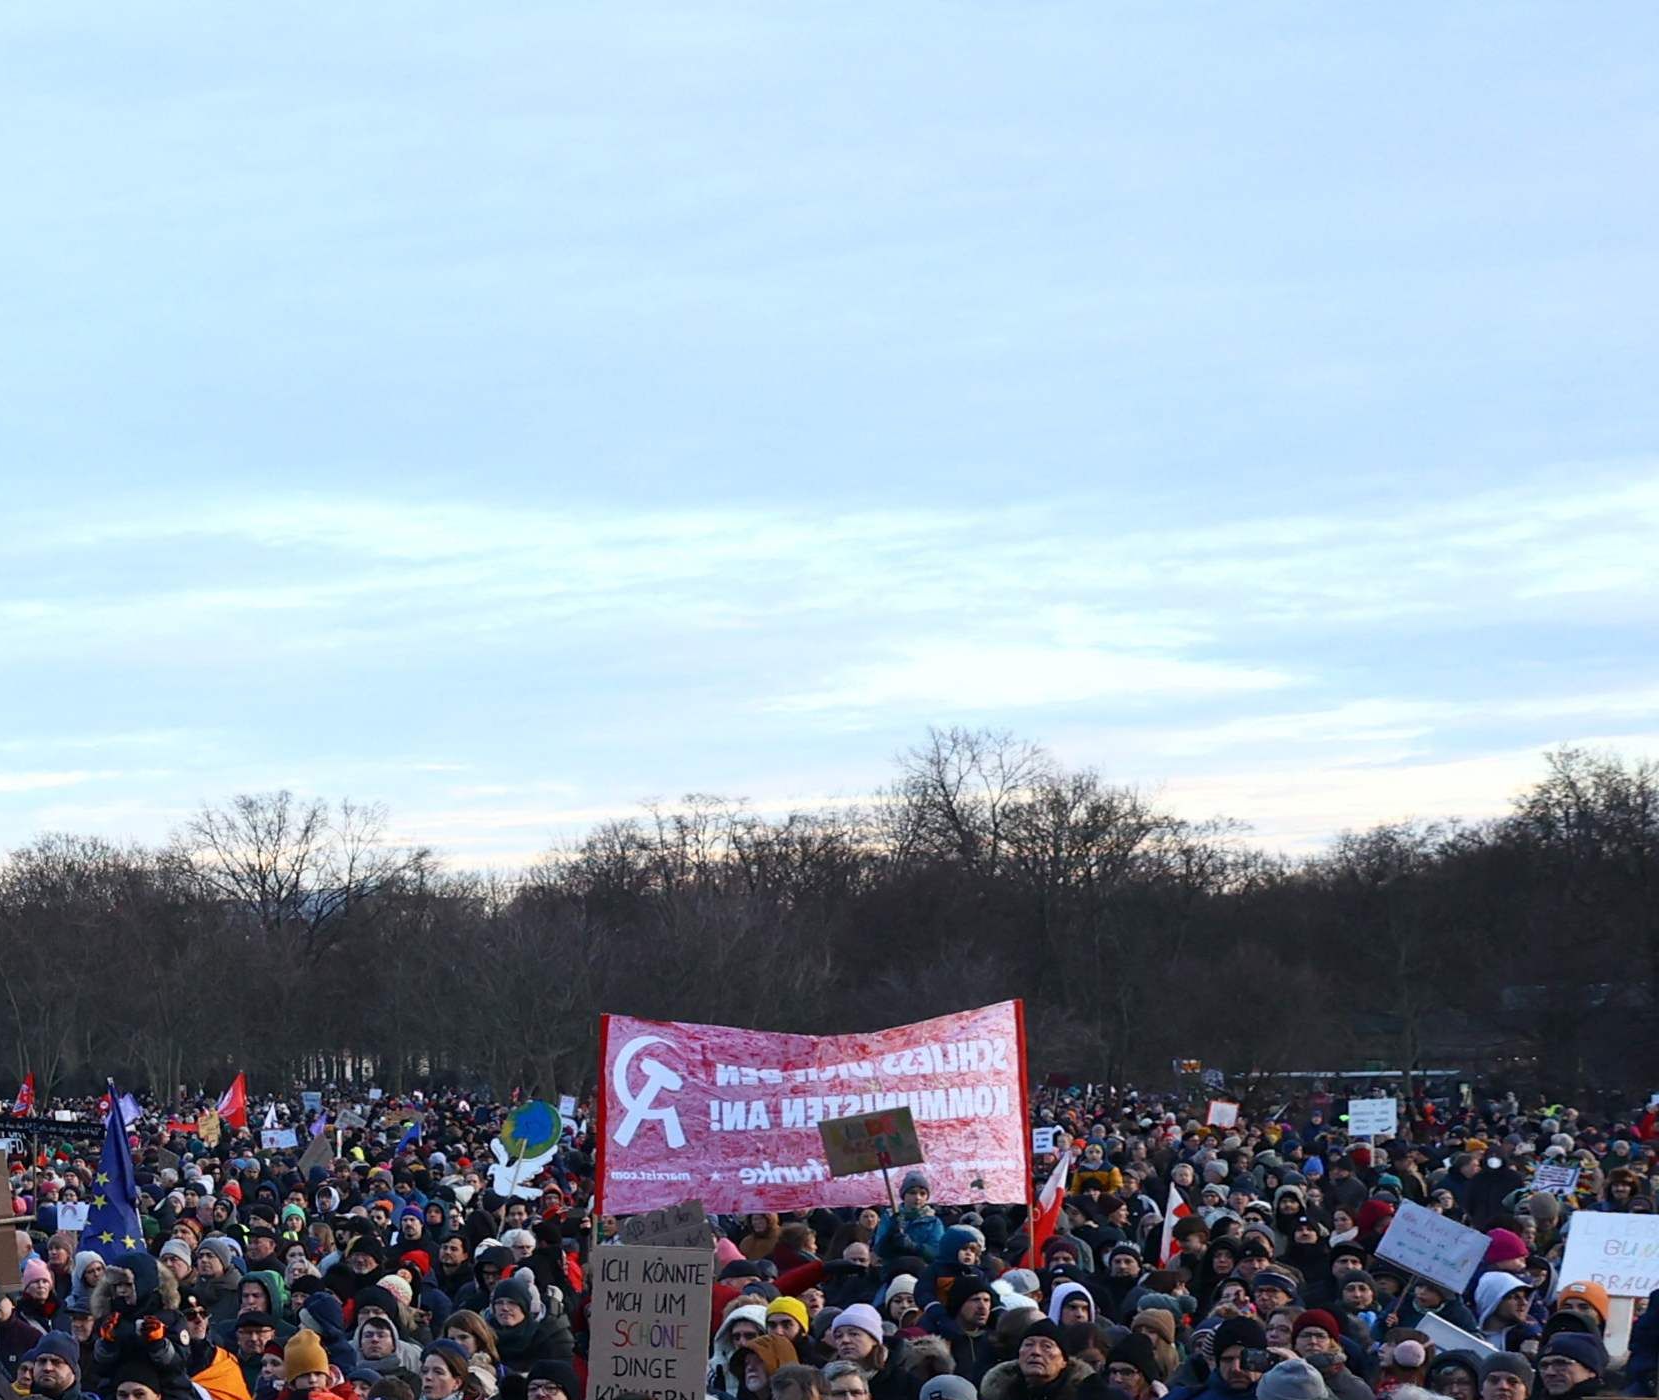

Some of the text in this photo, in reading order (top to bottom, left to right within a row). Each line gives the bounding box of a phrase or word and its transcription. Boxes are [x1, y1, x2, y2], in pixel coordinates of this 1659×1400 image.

[601, 1257, 709, 1285] ICH KÖNNTE
[605, 1291, 686, 1316] MICH UM
[612, 1319, 690, 1351] SCHÖNE
[611, 1355, 677, 1379] DINGE
